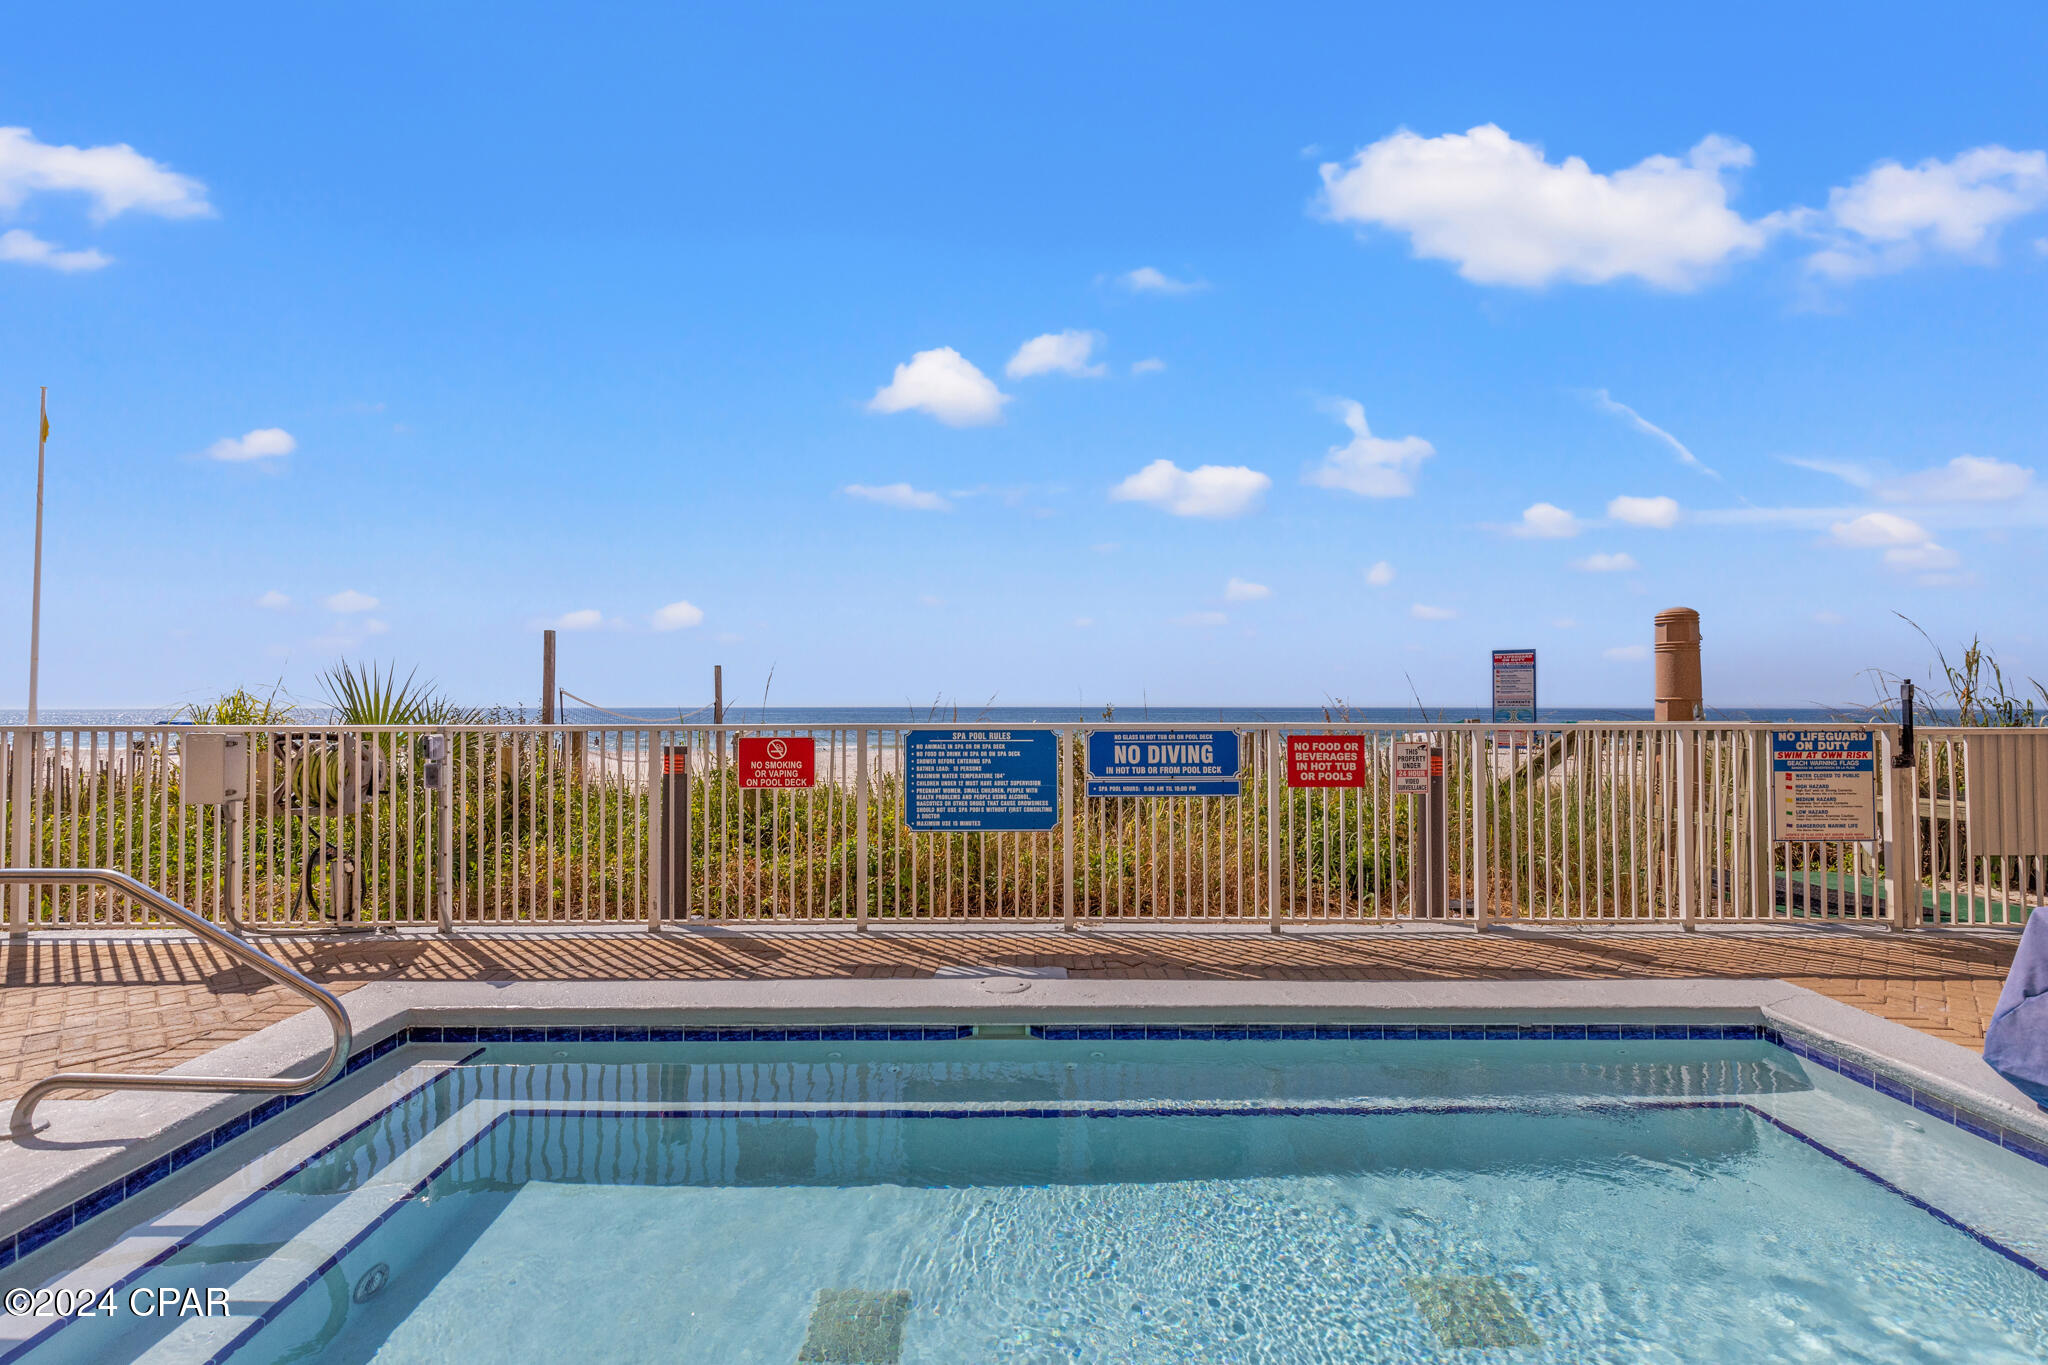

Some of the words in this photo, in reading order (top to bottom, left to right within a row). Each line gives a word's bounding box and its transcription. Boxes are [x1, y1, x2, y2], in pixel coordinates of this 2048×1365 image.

[1778, 733, 1795, 741] NO
[1801, 733, 1867, 741] LIFEGUARD
[1114, 745, 1140, 764] NO
[1148, 745, 1213, 764] DIVING
